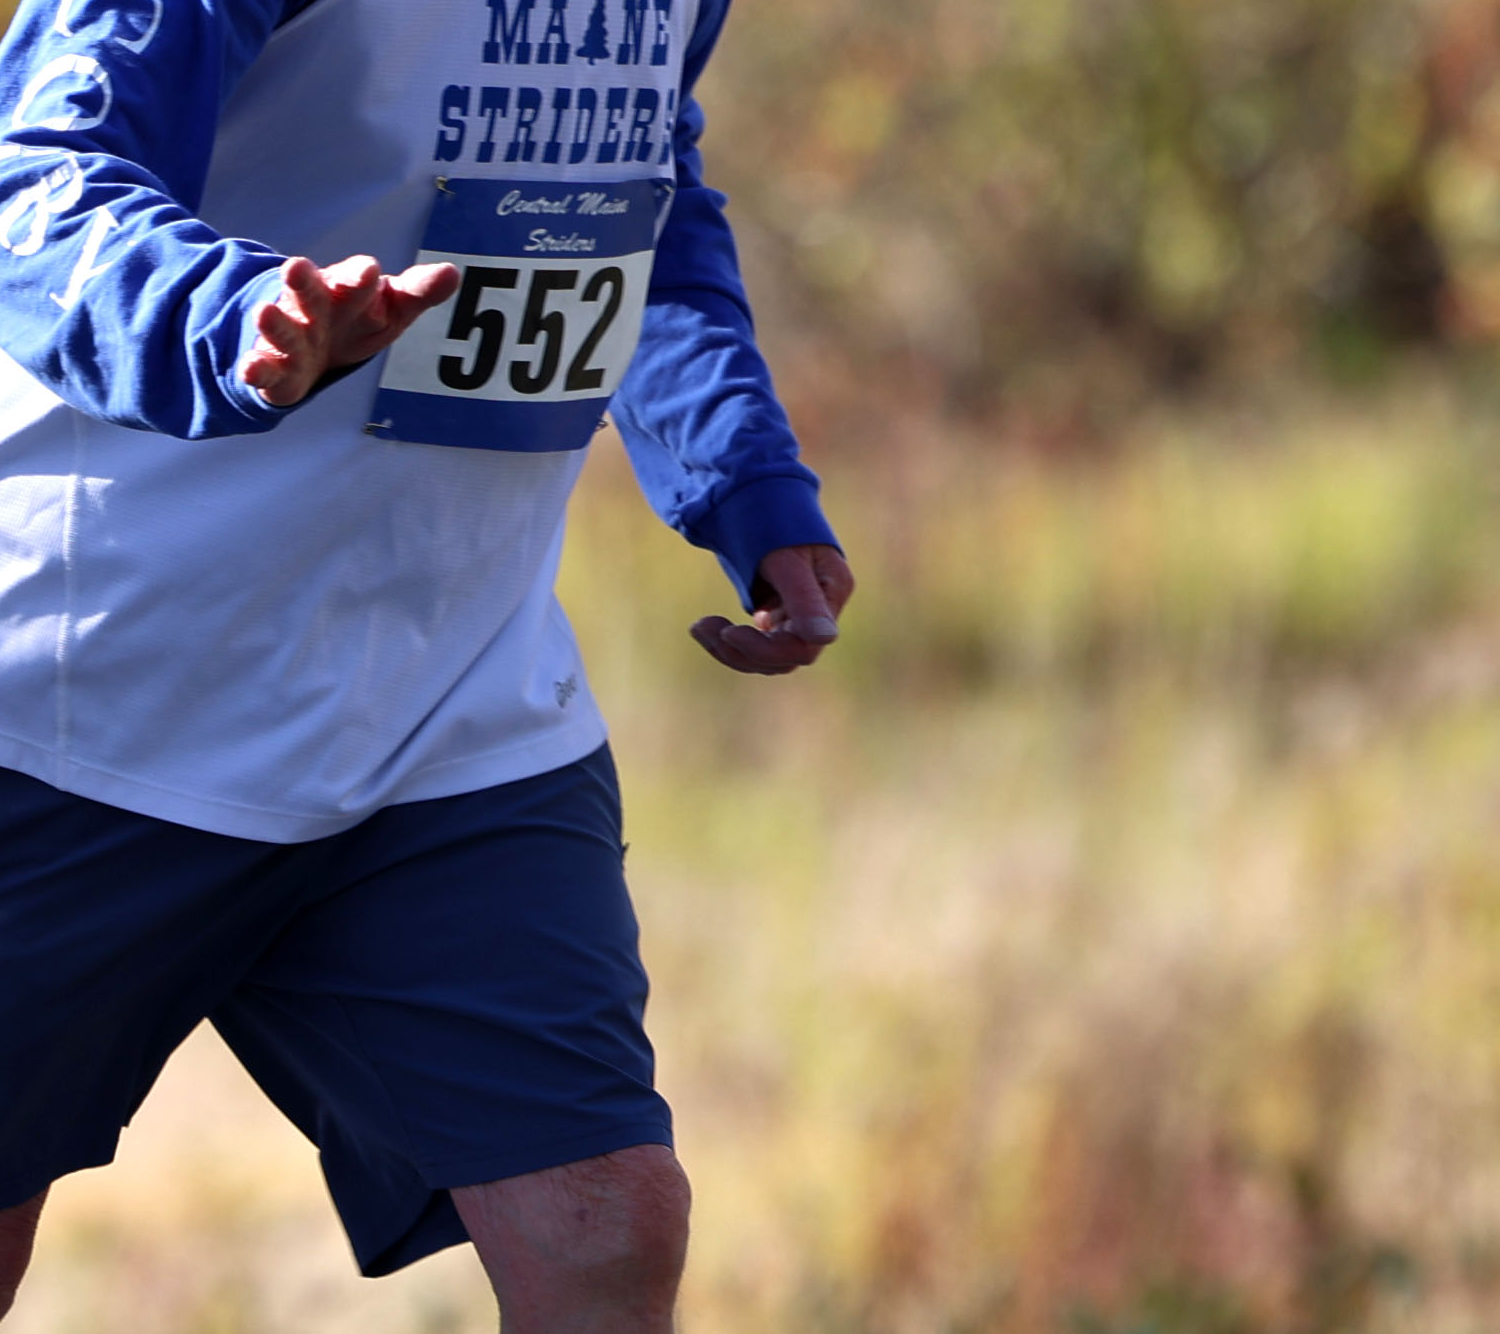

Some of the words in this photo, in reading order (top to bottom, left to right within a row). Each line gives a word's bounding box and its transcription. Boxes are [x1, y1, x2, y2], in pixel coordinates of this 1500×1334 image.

[496, 189, 574, 216] Central
[523, 228, 597, 252] Striders
[437, 265, 624, 395] 552
